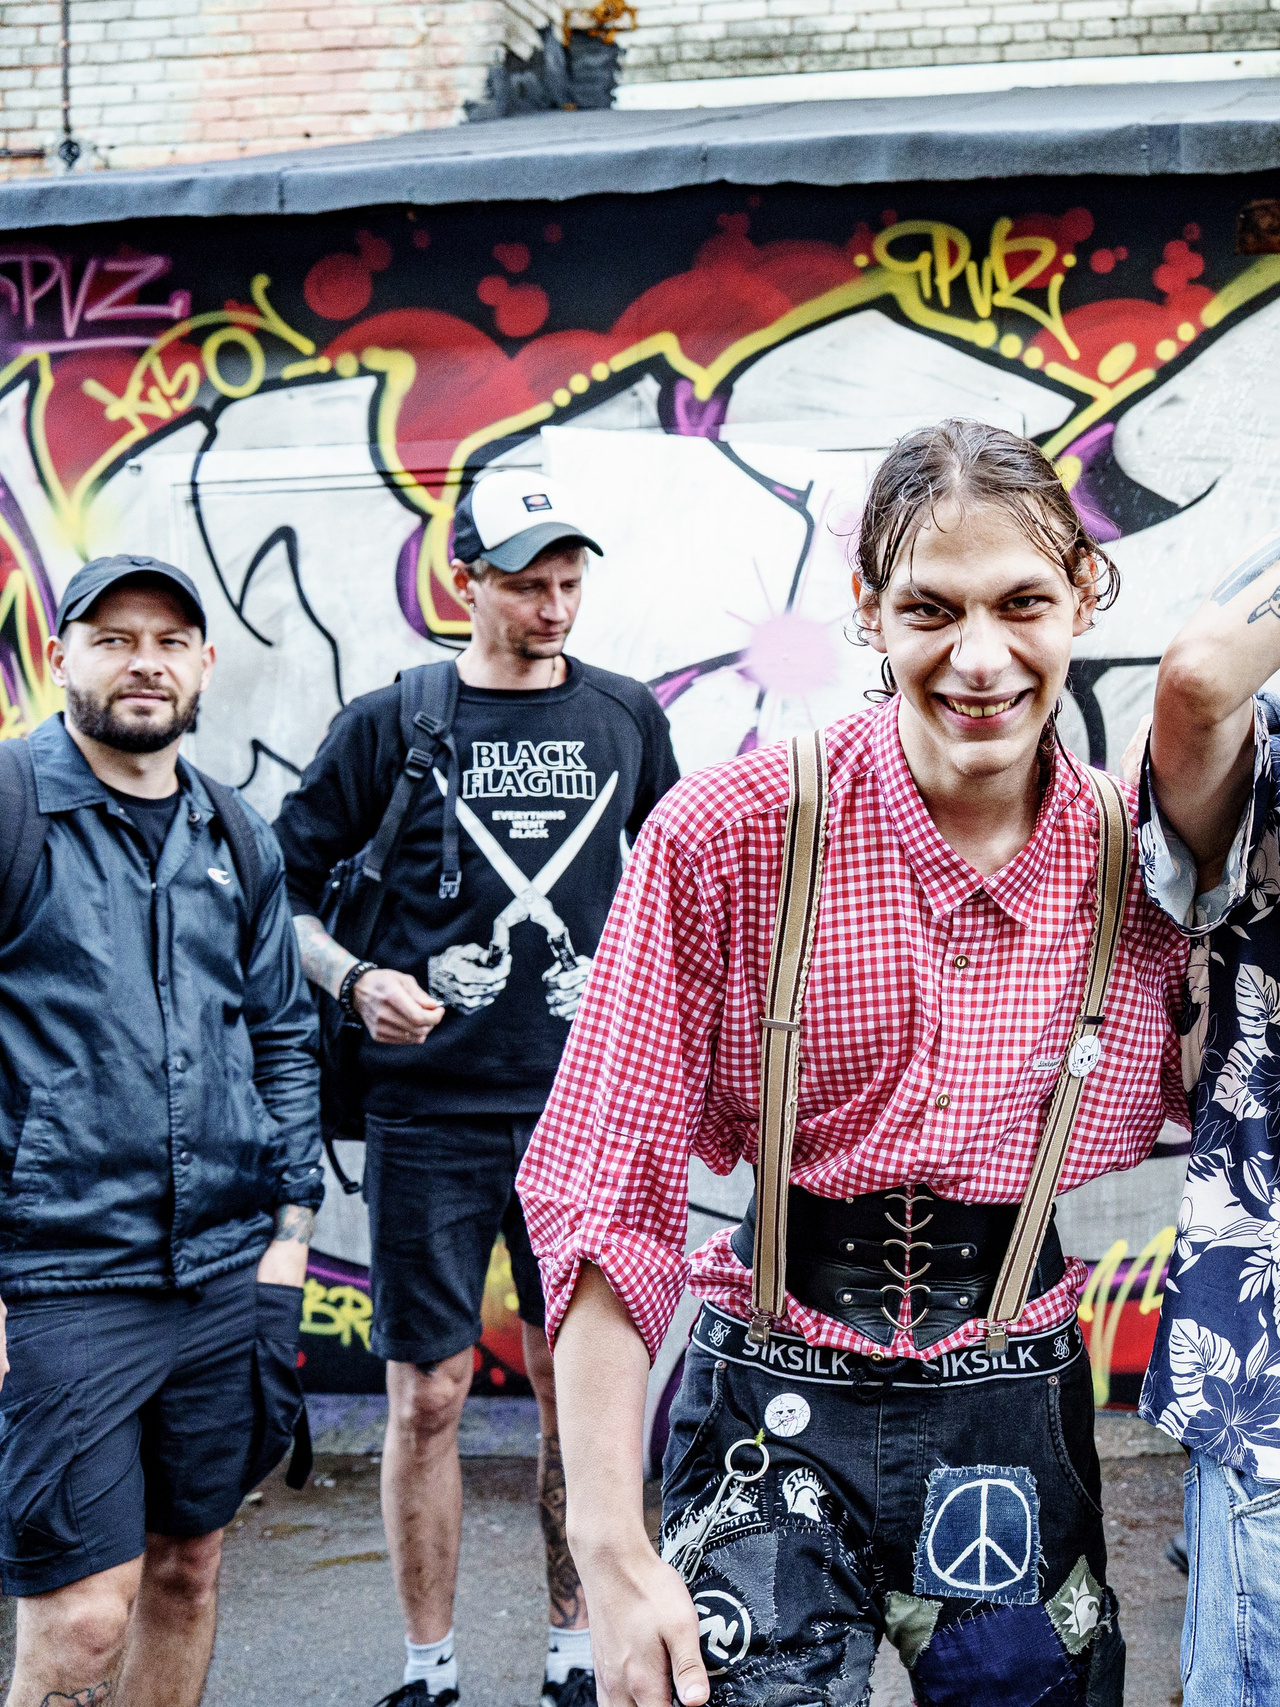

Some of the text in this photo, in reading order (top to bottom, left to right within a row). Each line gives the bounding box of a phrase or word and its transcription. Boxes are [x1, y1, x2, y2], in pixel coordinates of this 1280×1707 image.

[472, 741, 587, 770] BLACK
[492, 810, 566, 820] EVERYTHING
[511, 820, 546, 829] WENT
[509, 829, 549, 838] BLACK
[743, 1334, 850, 1375] SIKSILK
